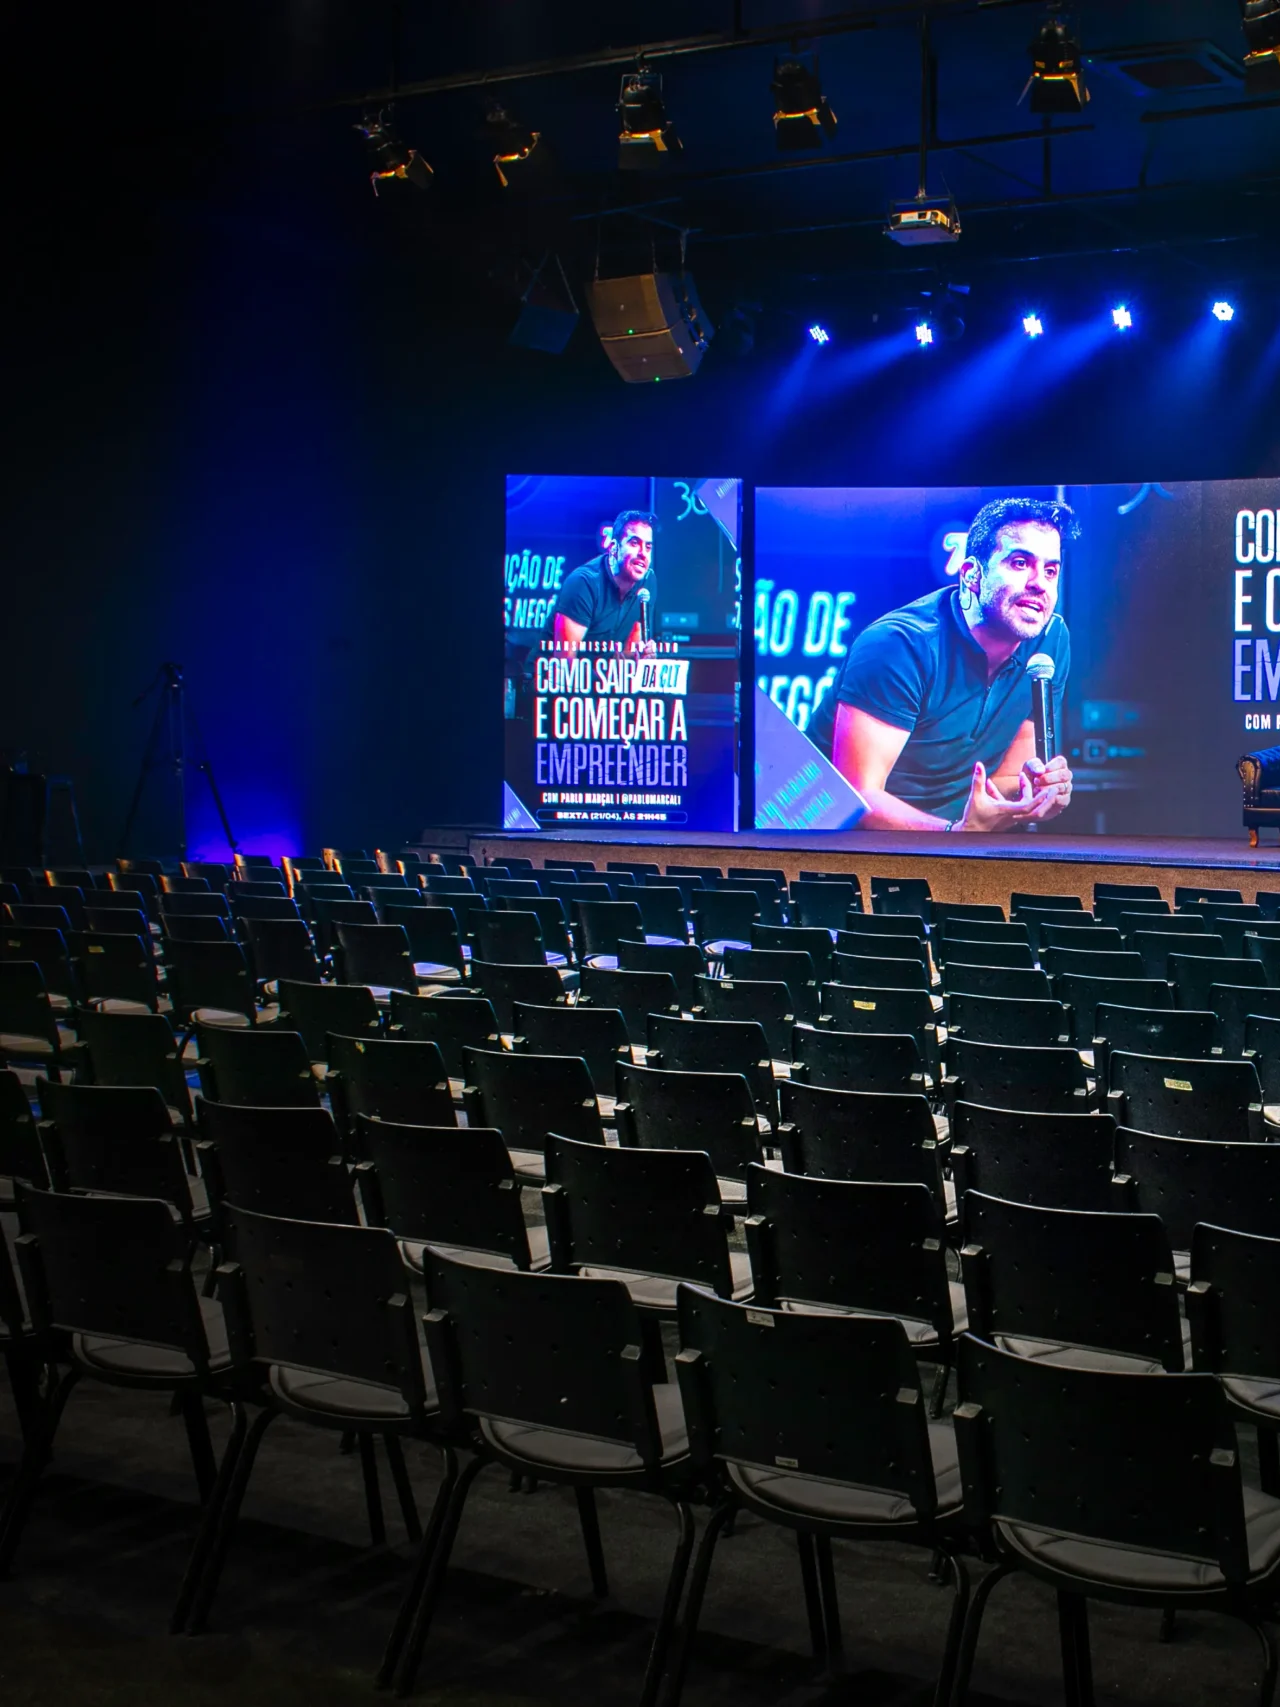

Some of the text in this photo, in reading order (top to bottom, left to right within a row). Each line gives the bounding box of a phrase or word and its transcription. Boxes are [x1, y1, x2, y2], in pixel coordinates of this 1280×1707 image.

[543, 556, 566, 590] DE
[1234, 569, 1252, 632] E
[804, 591, 855, 657] DE
[536, 657, 680, 694] COMO SAIR DA CLT
[536, 697, 687, 749] E COMEÇAR A
[1245, 714, 1271, 730] COM
[536, 743, 687, 786] EMPREENDER
[542, 792, 558, 803] COM
[560, 793, 583, 804] PABLO
[585, 793, 614, 806] MARÇAL
[555, 811, 588, 820] SEXTA
[623, 811, 635, 820] ÀS
